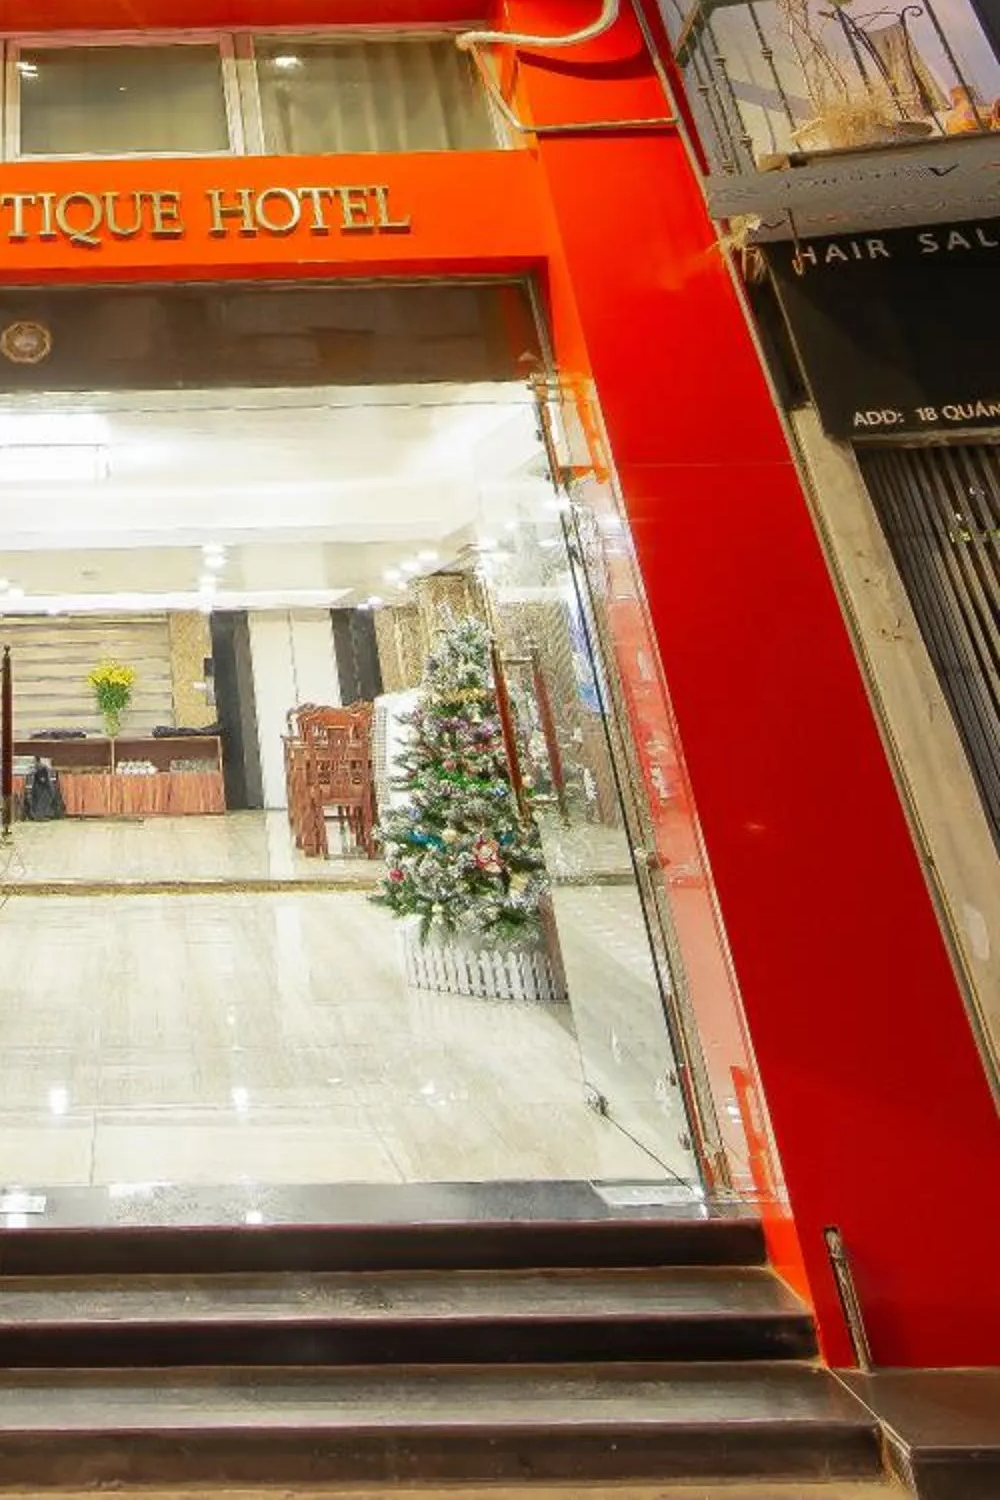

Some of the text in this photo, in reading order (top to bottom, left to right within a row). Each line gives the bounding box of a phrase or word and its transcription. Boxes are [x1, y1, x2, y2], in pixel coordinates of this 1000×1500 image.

[206, 185, 411, 239] HOTEL
[796, 239, 890, 265] HAIR
[853, 410, 905, 426] ADD:
[916, 407, 939, 420] 18
